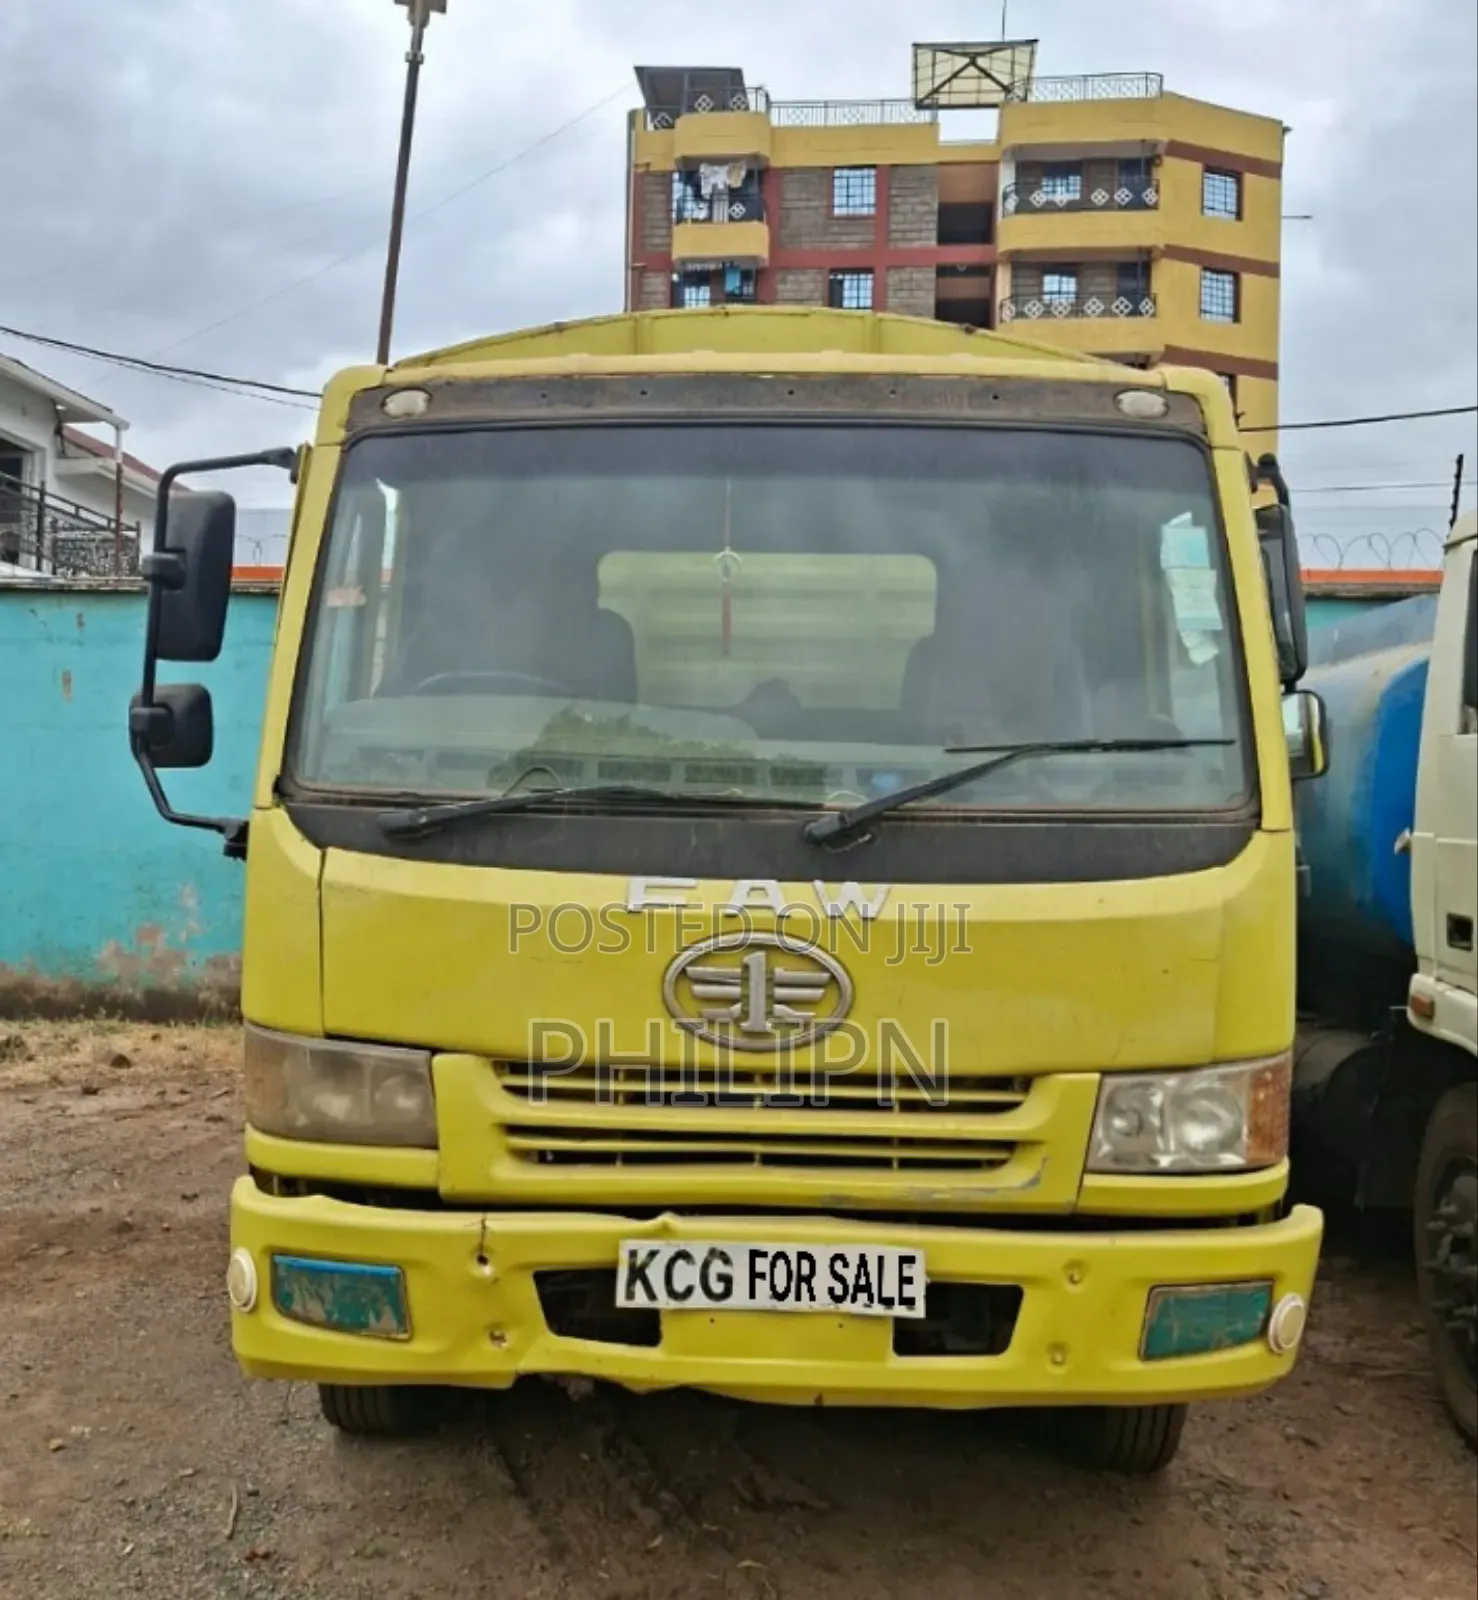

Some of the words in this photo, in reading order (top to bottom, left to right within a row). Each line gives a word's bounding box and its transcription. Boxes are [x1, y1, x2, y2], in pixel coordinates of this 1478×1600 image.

[626, 876, 892, 919] FAW
[625, 1248, 734, 1302] KCG
[748, 1249, 817, 1302] FOR
[827, 1252, 916, 1307] SALE
